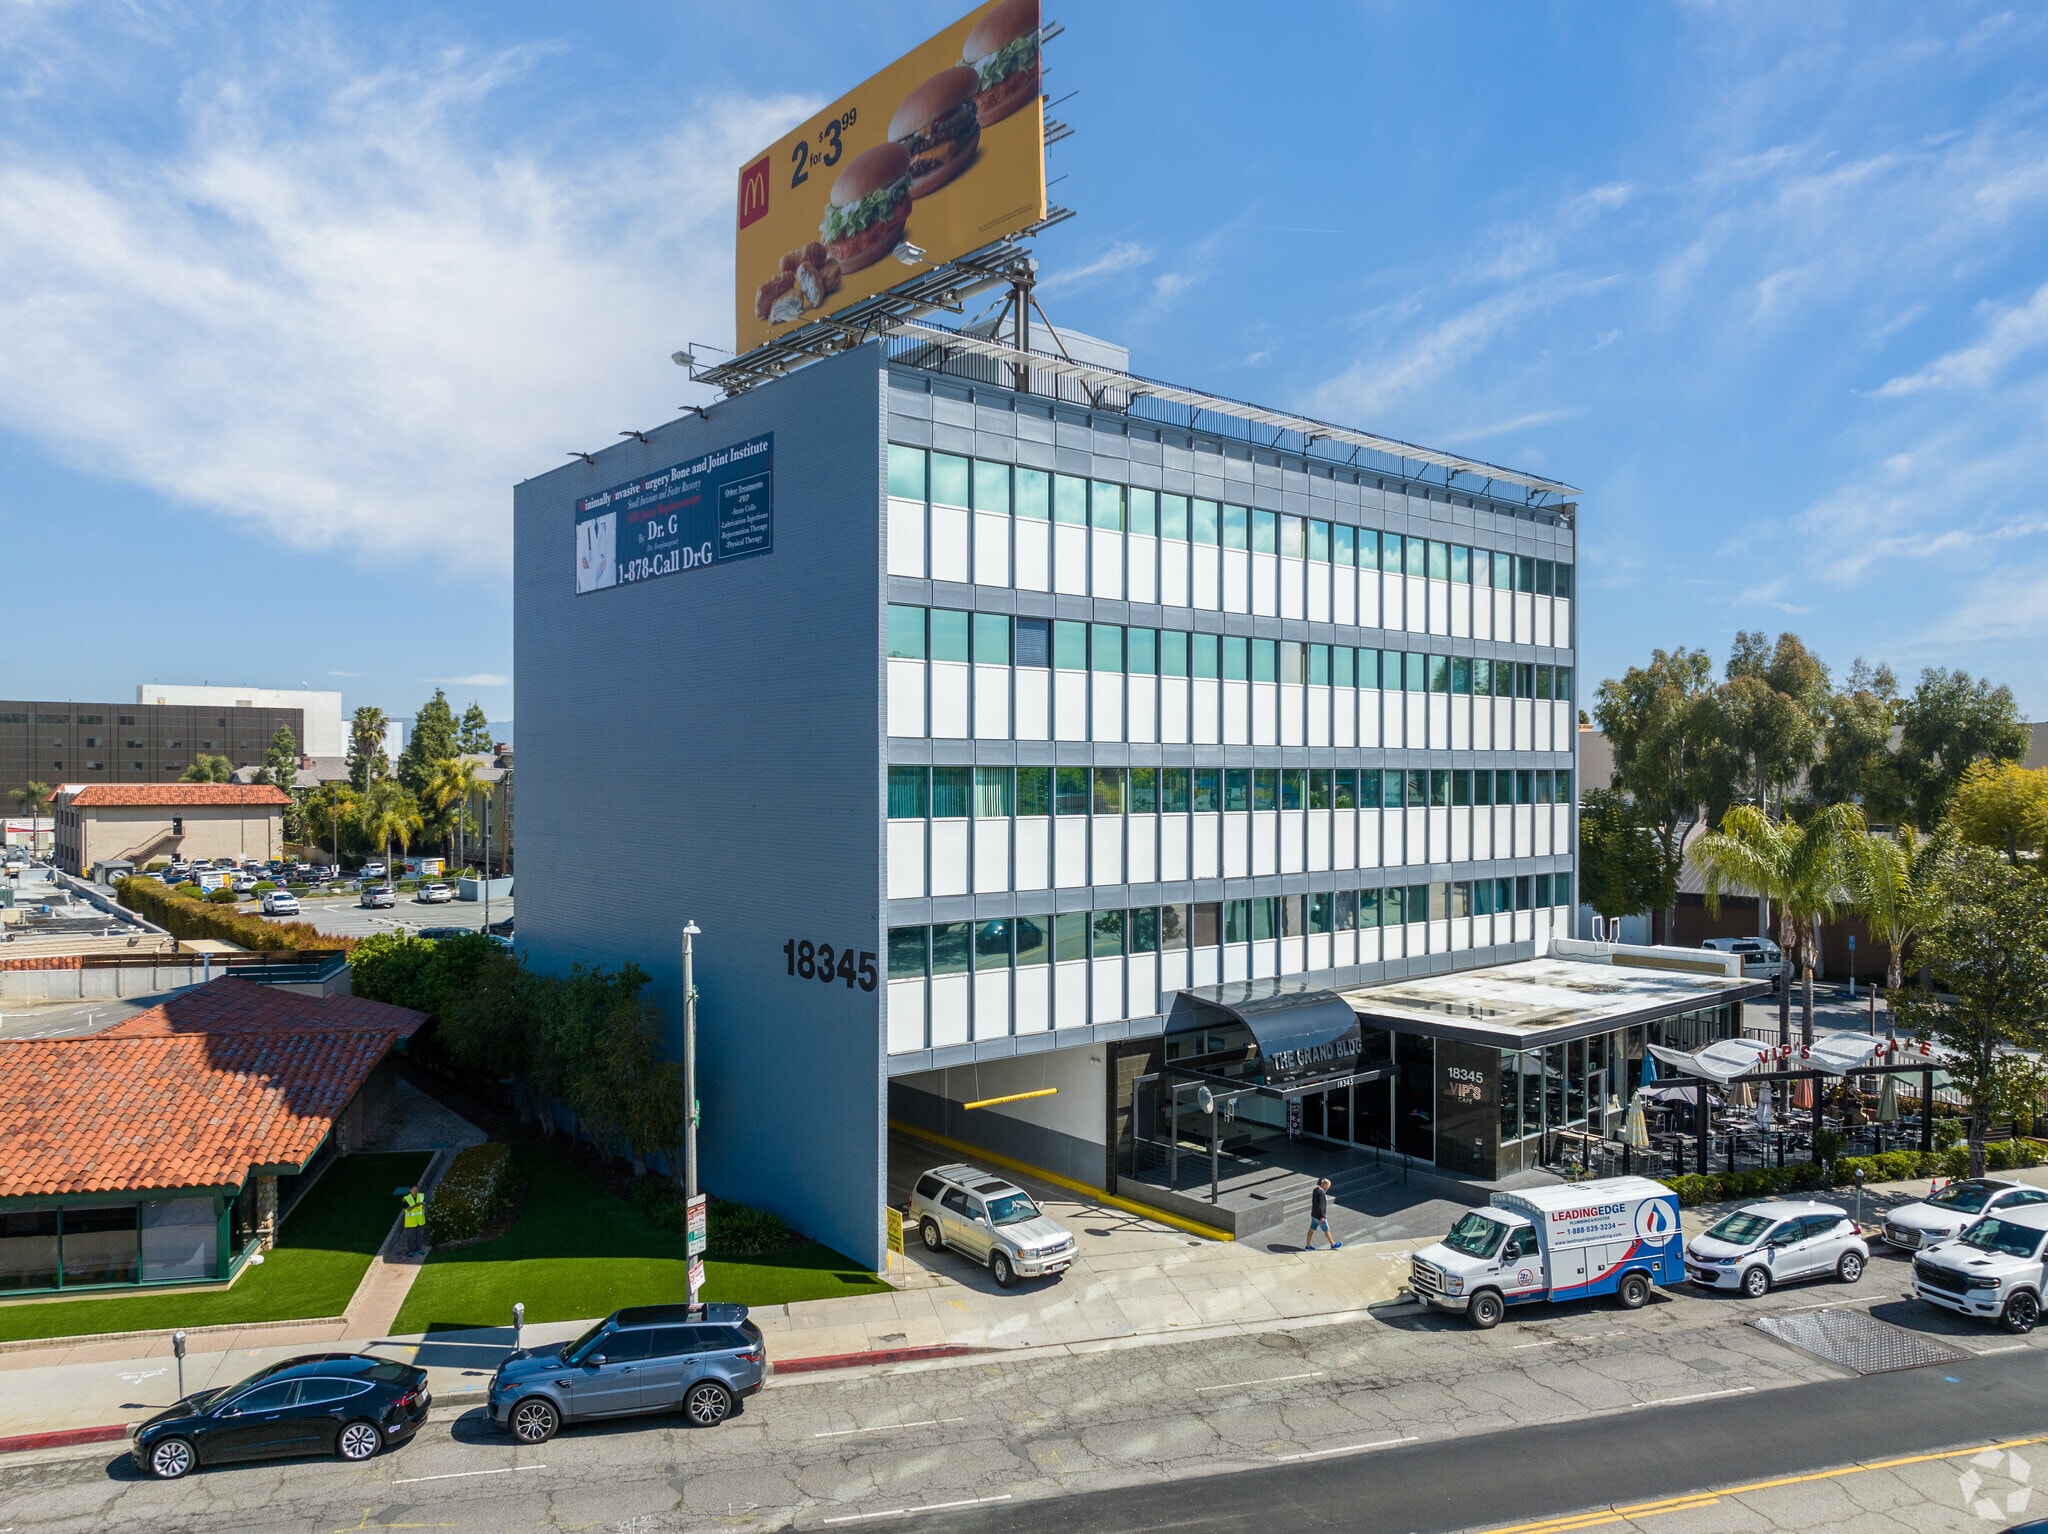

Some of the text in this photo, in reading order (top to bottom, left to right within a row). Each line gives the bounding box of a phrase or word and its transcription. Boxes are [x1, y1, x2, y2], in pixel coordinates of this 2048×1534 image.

[791, 140, 809, 189] 2
[809, 151, 823, 168] for
[671, 468, 690, 481] Bone
[692, 457, 707, 474] and
[706, 453, 728, 473] Joint
[730, 441, 768, 462] Institute
[647, 521, 664, 541] Dr.
[668, 514, 678, 534] G
[618, 549, 679, 584] 1-878-Call
[682, 541, 713, 569] DrG
[783, 938, 877, 992] 18345
[1271, 1037, 1362, 1071] THE GRAND BLDG
[1337, 1077, 1354, 1088] 18345
[1447, 1066, 1484, 1083] 18345
[1551, 1203, 1626, 1222] LEADINGEDGE
